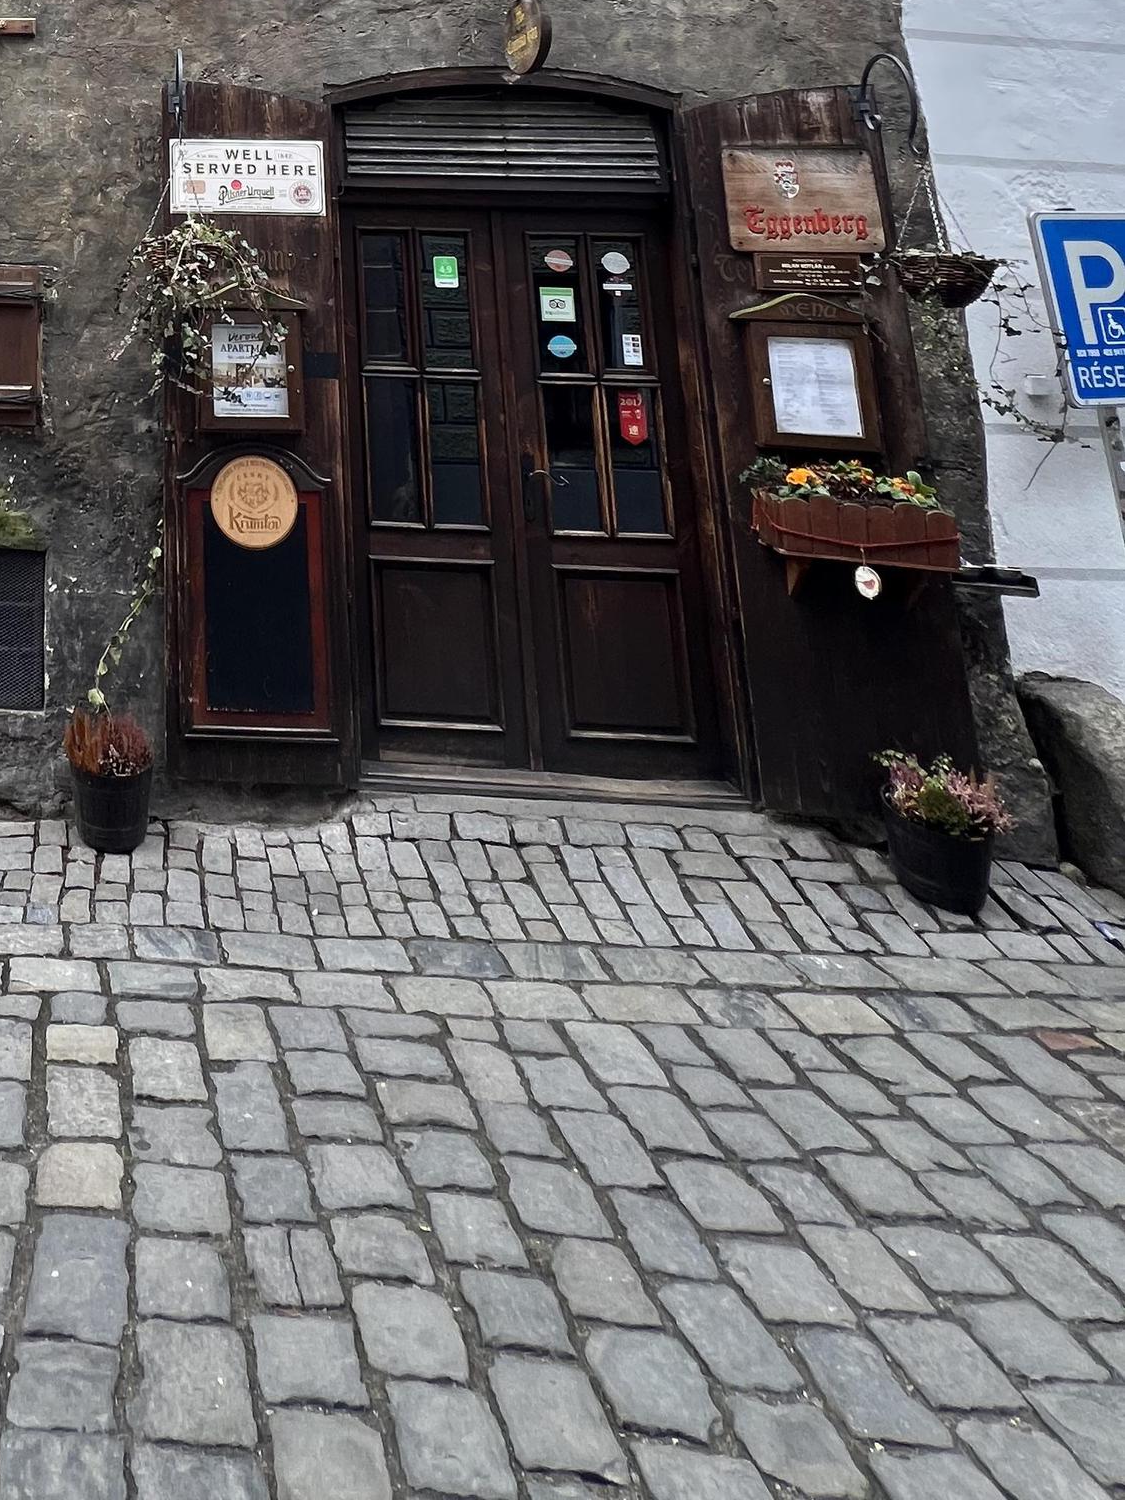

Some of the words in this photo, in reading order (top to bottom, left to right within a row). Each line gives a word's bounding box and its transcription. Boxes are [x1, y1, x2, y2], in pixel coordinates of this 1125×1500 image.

[225, 149, 273, 161] WELL
[183, 162, 257, 175] SERVED
[267, 164, 317, 176] HERE
[218, 185, 247, 206] Pilsner
[742, 204, 869, 241] Eggenberg
[1063, 240, 1125, 345] P
